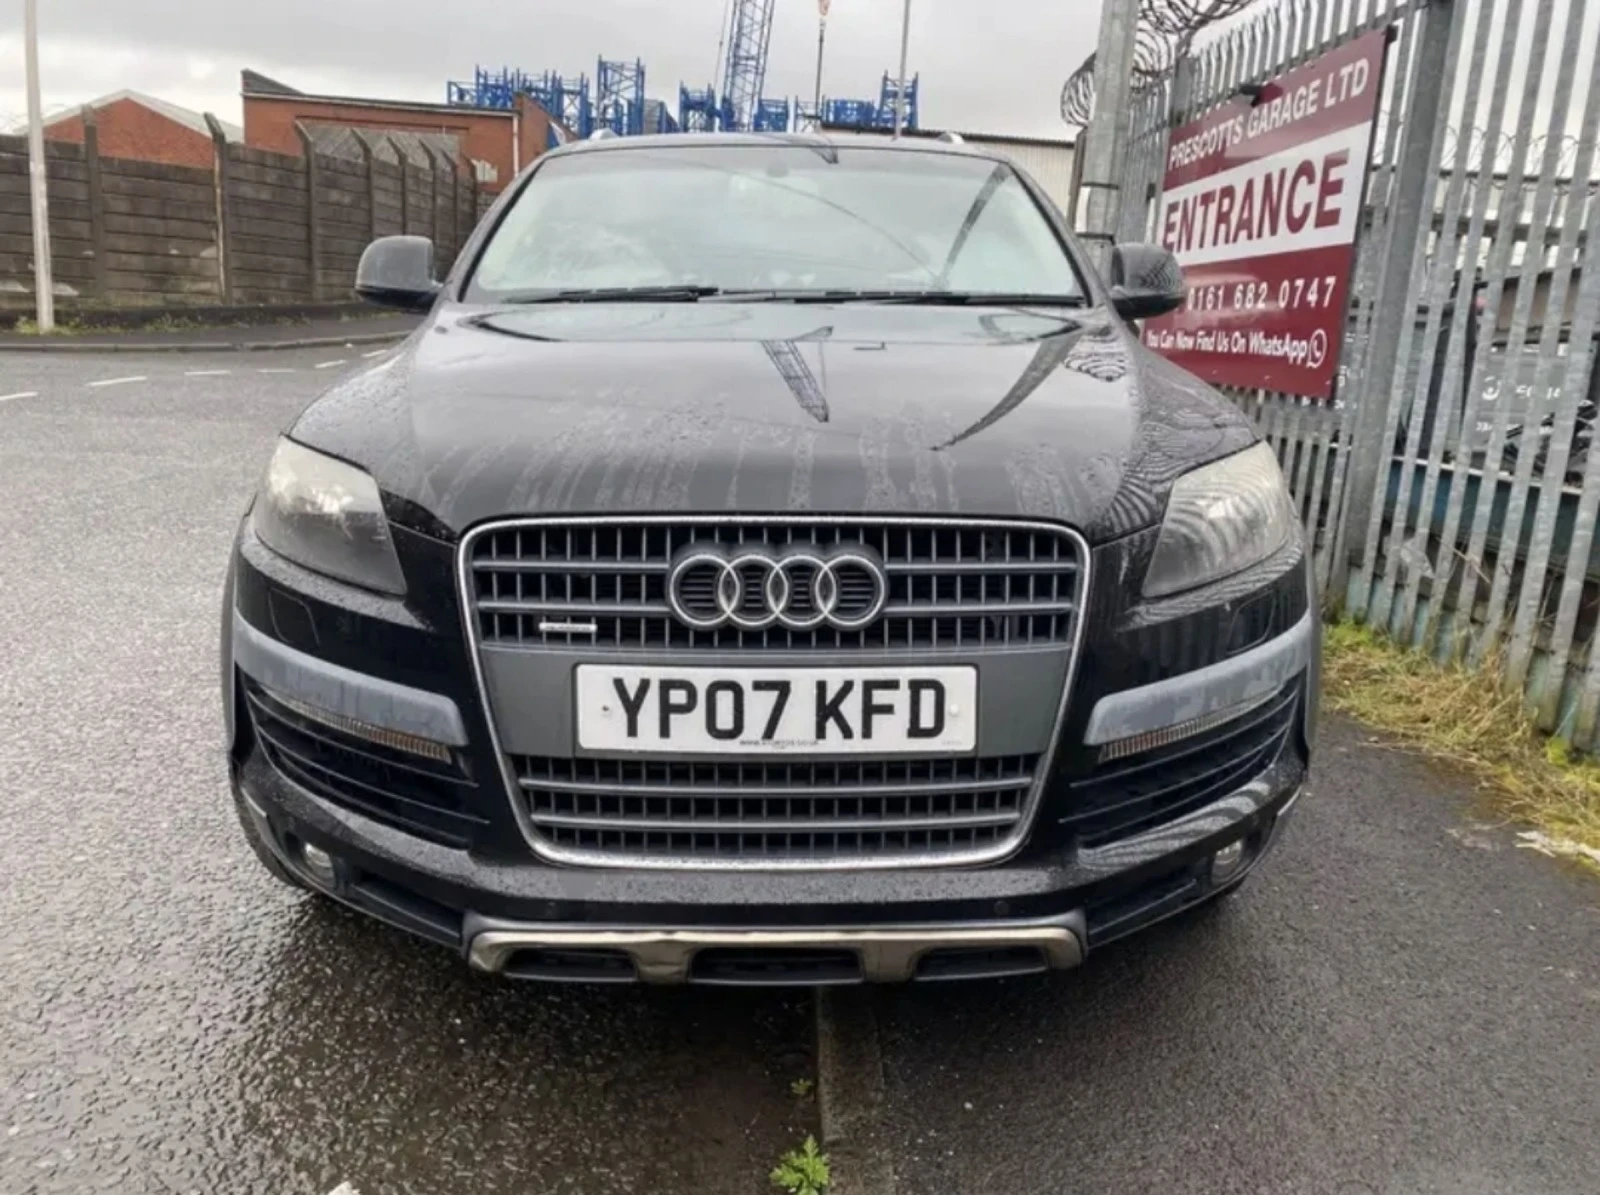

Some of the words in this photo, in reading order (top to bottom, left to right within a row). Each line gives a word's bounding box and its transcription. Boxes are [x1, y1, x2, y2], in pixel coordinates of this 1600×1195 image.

[1168, 113, 1244, 171] PRESCOTTS
[1247, 77, 1321, 139] GARAGE
[1325, 58, 1369, 108] LTD
[1162, 147, 1350, 254] ENTRANCE
[1187, 285, 1224, 311] 0161
[1233, 281, 1268, 310] 682
[1277, 275, 1337, 309] 0747
[1160, 329, 1175, 350] Can
[1176, 330, 1195, 351] Now
[1196, 330, 1216, 352] Find
[1217, 330, 1229, 353] Us
[1231, 331, 1247, 353] On
[1248, 330, 1308, 365] WhatsApp
[612, 677, 792, 740] YP07
[815, 679, 946, 739] KFD
